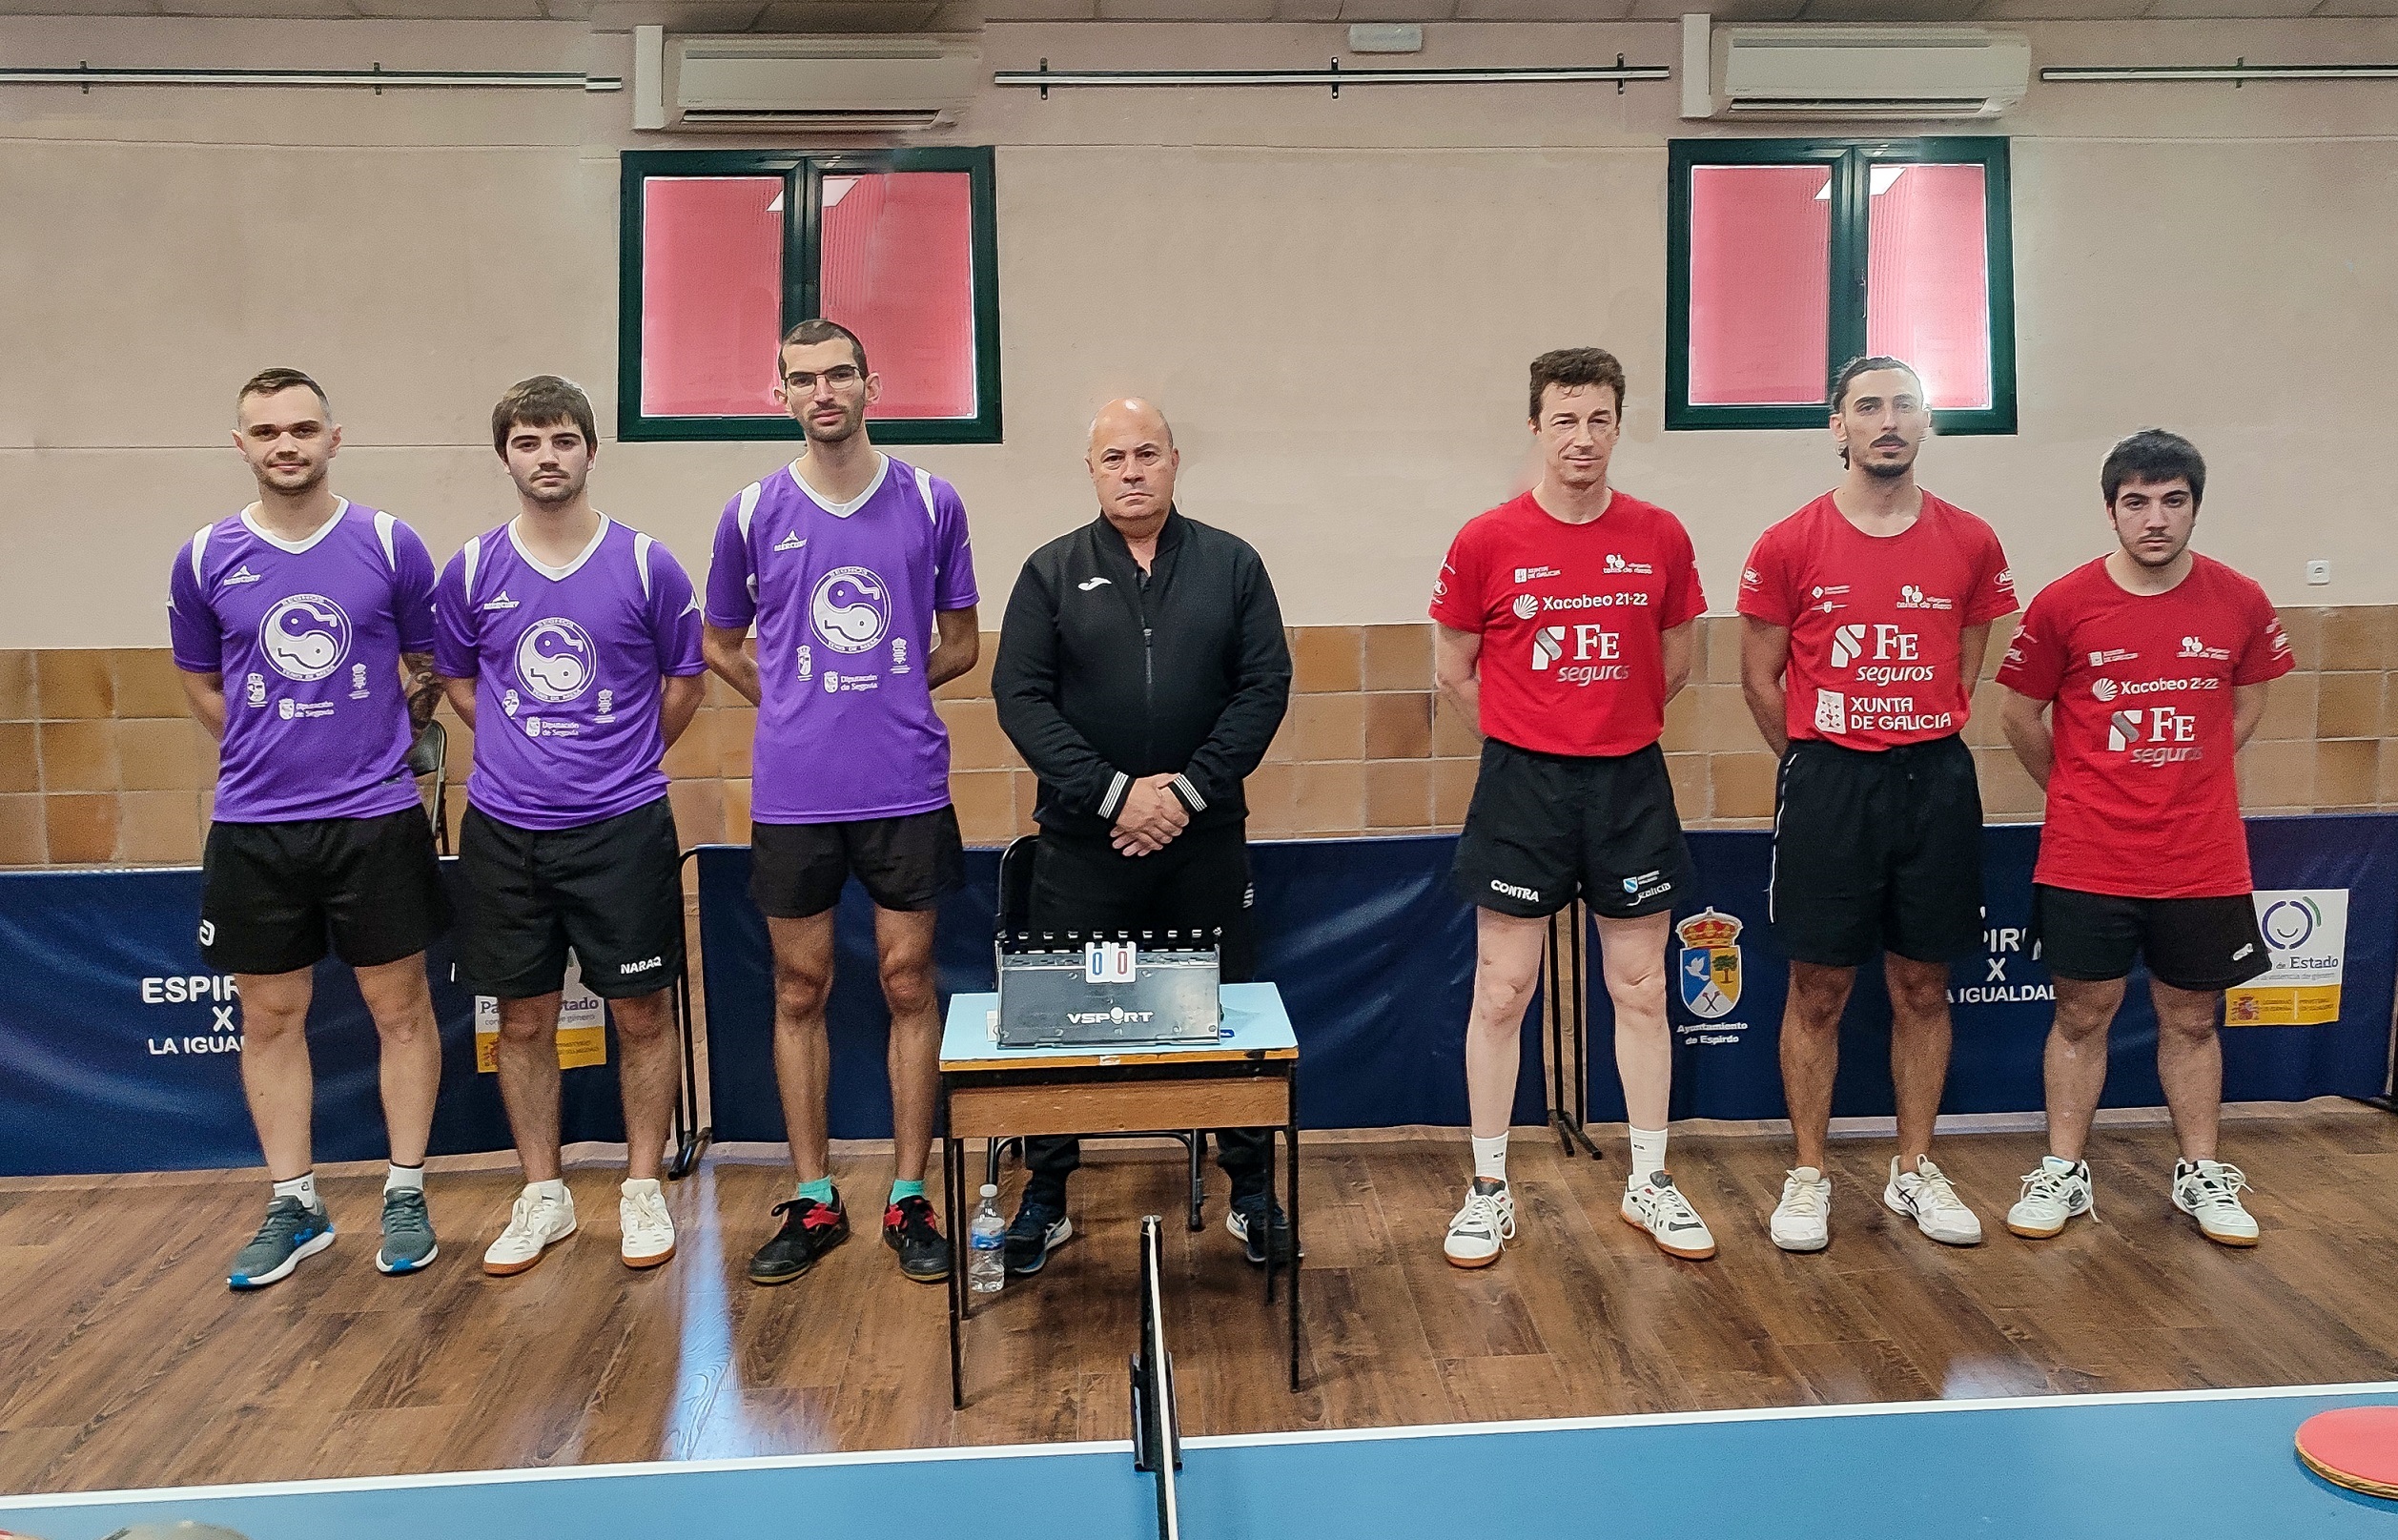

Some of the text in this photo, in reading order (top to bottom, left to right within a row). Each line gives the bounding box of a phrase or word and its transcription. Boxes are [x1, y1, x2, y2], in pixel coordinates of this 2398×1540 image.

[1542, 593, 1613, 610] Xacobeo
[1855, 665, 1936, 687] seguros
[2121, 677, 2188, 695] Xacobeo
[1850, 697, 1914, 713] XUNTA
[1851, 712, 1952, 730] DE GALICIA
[2130, 746, 2203, 768] segur
[1490, 879, 1540, 902] CONTRA
[1986, 957, 2005, 981] X
[2289, 955, 2339, 969] Estado
[142, 975, 240, 1003] ESPIR
[561, 997, 599, 1011] tado
[212, 1006, 235, 1032] X
[1676, 1022, 1749, 1034] Ayuntamiento
[148, 1036, 245, 1055] LA IGUA
[1700, 1035, 1740, 1045] Espirdo
